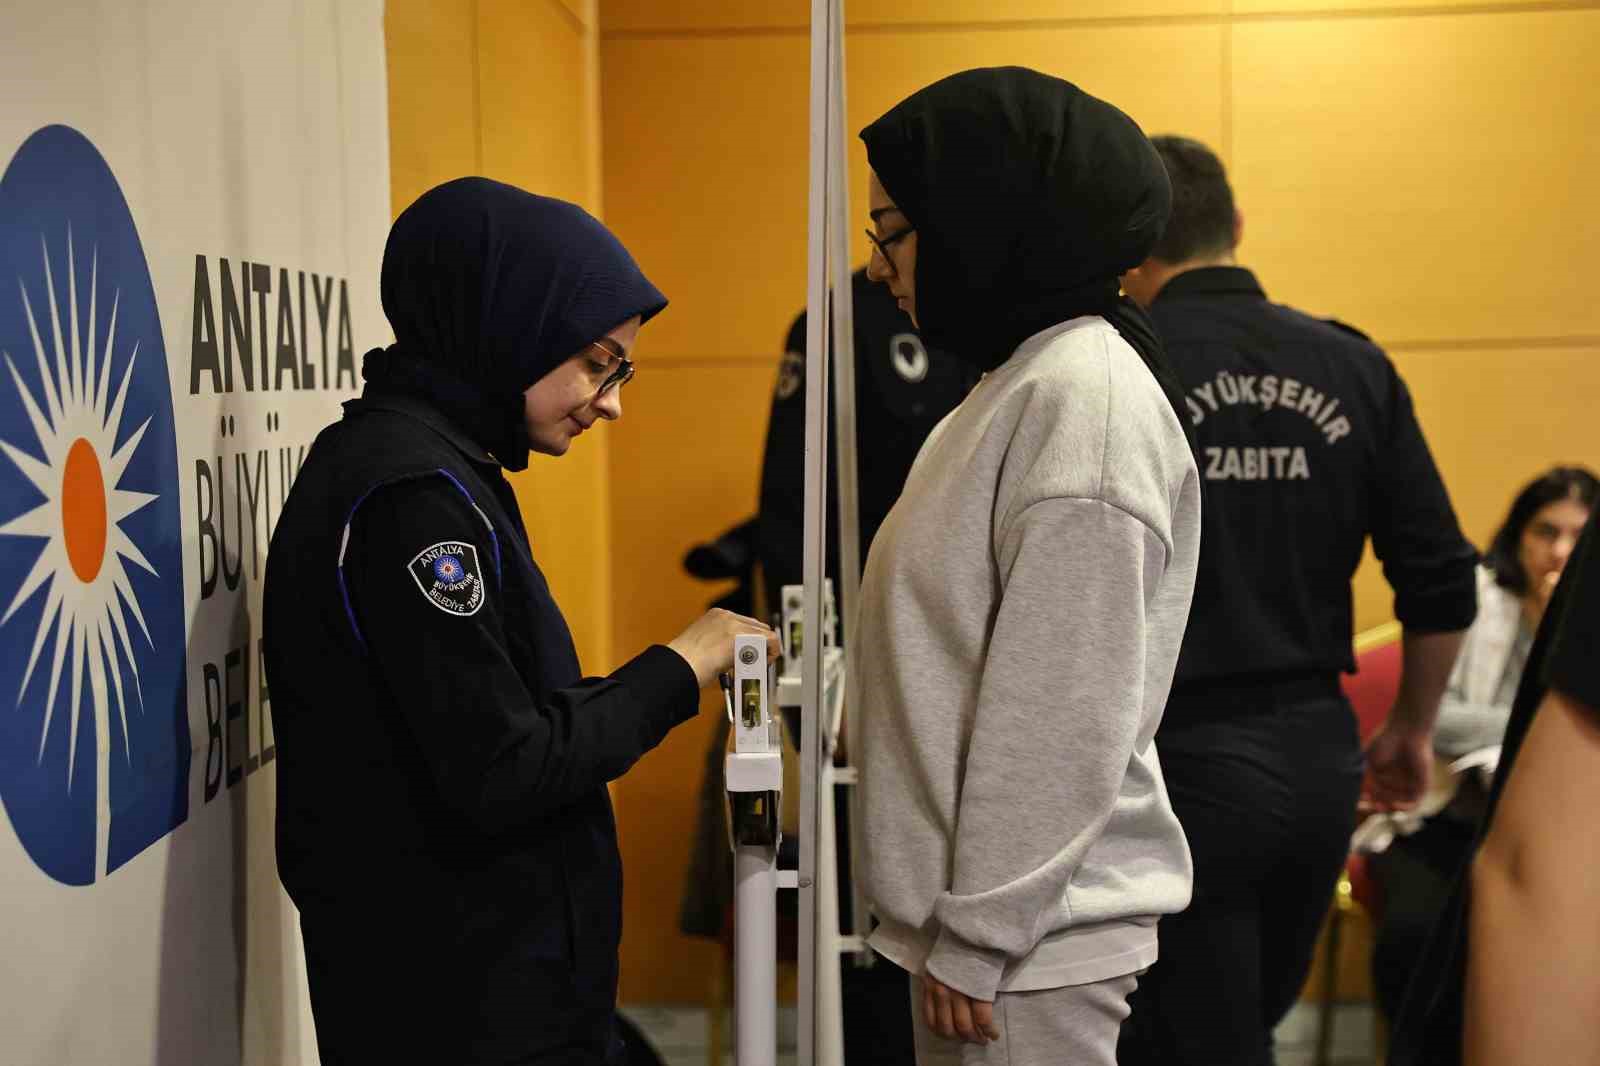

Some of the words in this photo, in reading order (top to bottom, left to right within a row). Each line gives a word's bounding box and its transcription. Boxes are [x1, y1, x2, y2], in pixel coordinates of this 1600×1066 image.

[190, 254, 356, 394] ANTALYA
[1205, 448, 1310, 480] ZABITA
[195, 411, 313, 600] BÜYÜ
[420, 545, 464, 567] ANTALYA
[429, 588, 464, 611] BELEDİYE
